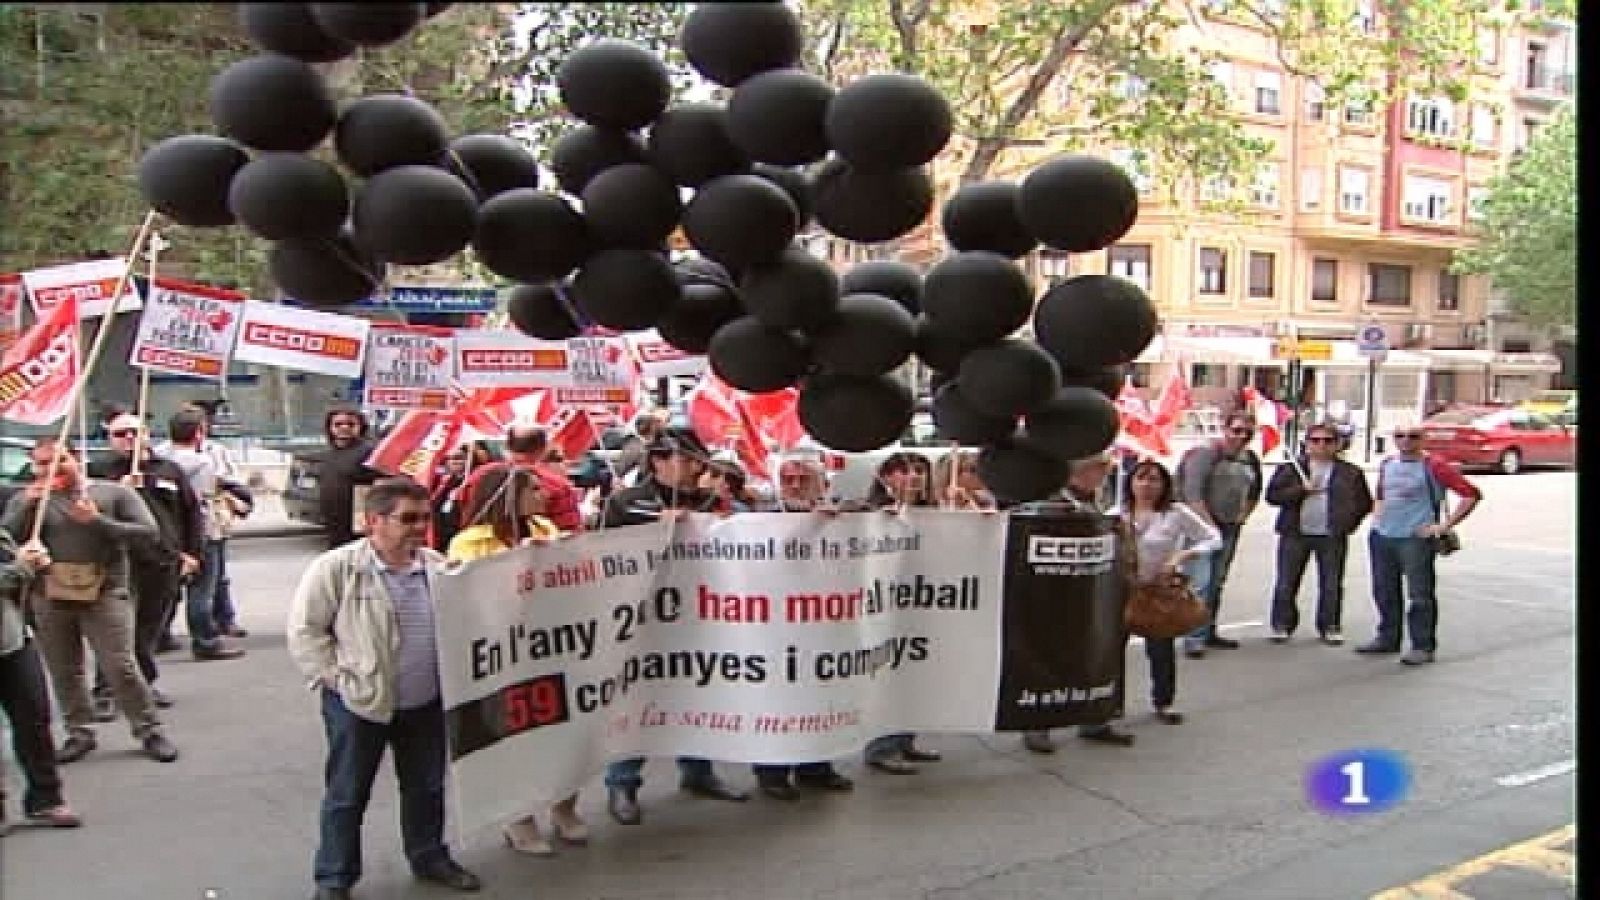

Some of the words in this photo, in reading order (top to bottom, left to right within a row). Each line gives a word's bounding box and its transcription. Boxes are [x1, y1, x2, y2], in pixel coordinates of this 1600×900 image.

[249, 325, 325, 351] CCOO
[467, 352, 532, 366] CCOO
[544, 558, 597, 588] abril
[602, 554, 638, 577] Dia
[784, 535, 811, 560] de
[820, 536, 841, 560] la
[471, 636, 503, 680] En
[509, 619, 598, 663] l'any
[697, 583, 770, 623] han
[505, 682, 558, 732] 59
[575, 649, 767, 713] copanyes
[787, 646, 798, 682] i
